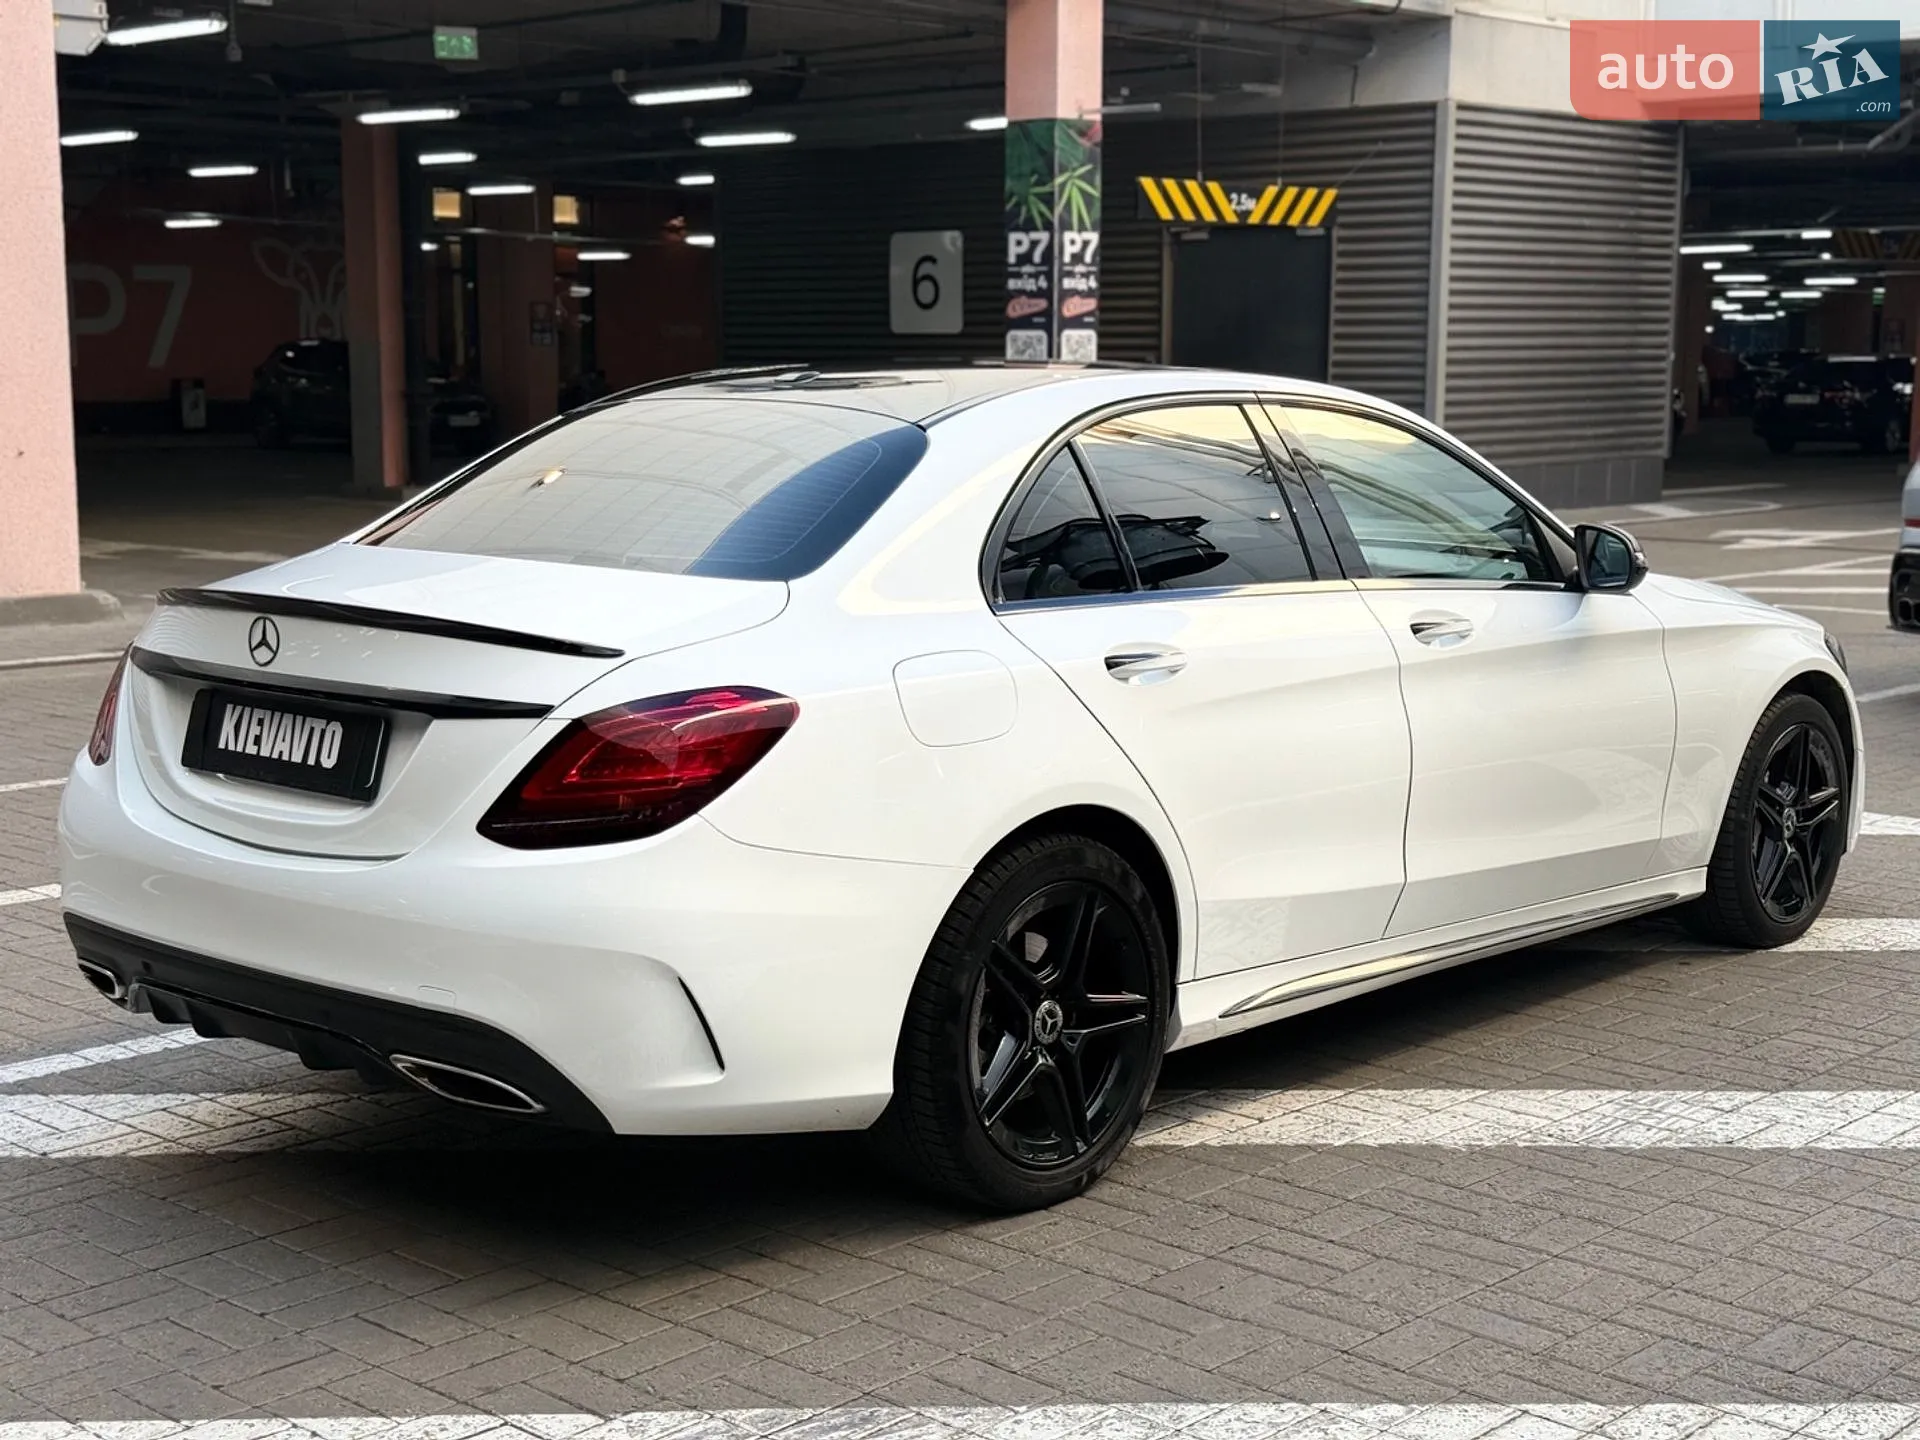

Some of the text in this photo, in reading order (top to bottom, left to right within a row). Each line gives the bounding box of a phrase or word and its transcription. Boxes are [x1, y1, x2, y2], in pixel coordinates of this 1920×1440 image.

[1007, 231, 1051, 265] P7
[1062, 231, 1100, 264] P7
[912, 254, 940, 310] 6
[67, 262, 192, 370] P7
[218, 703, 343, 769] KIEVAVTO
